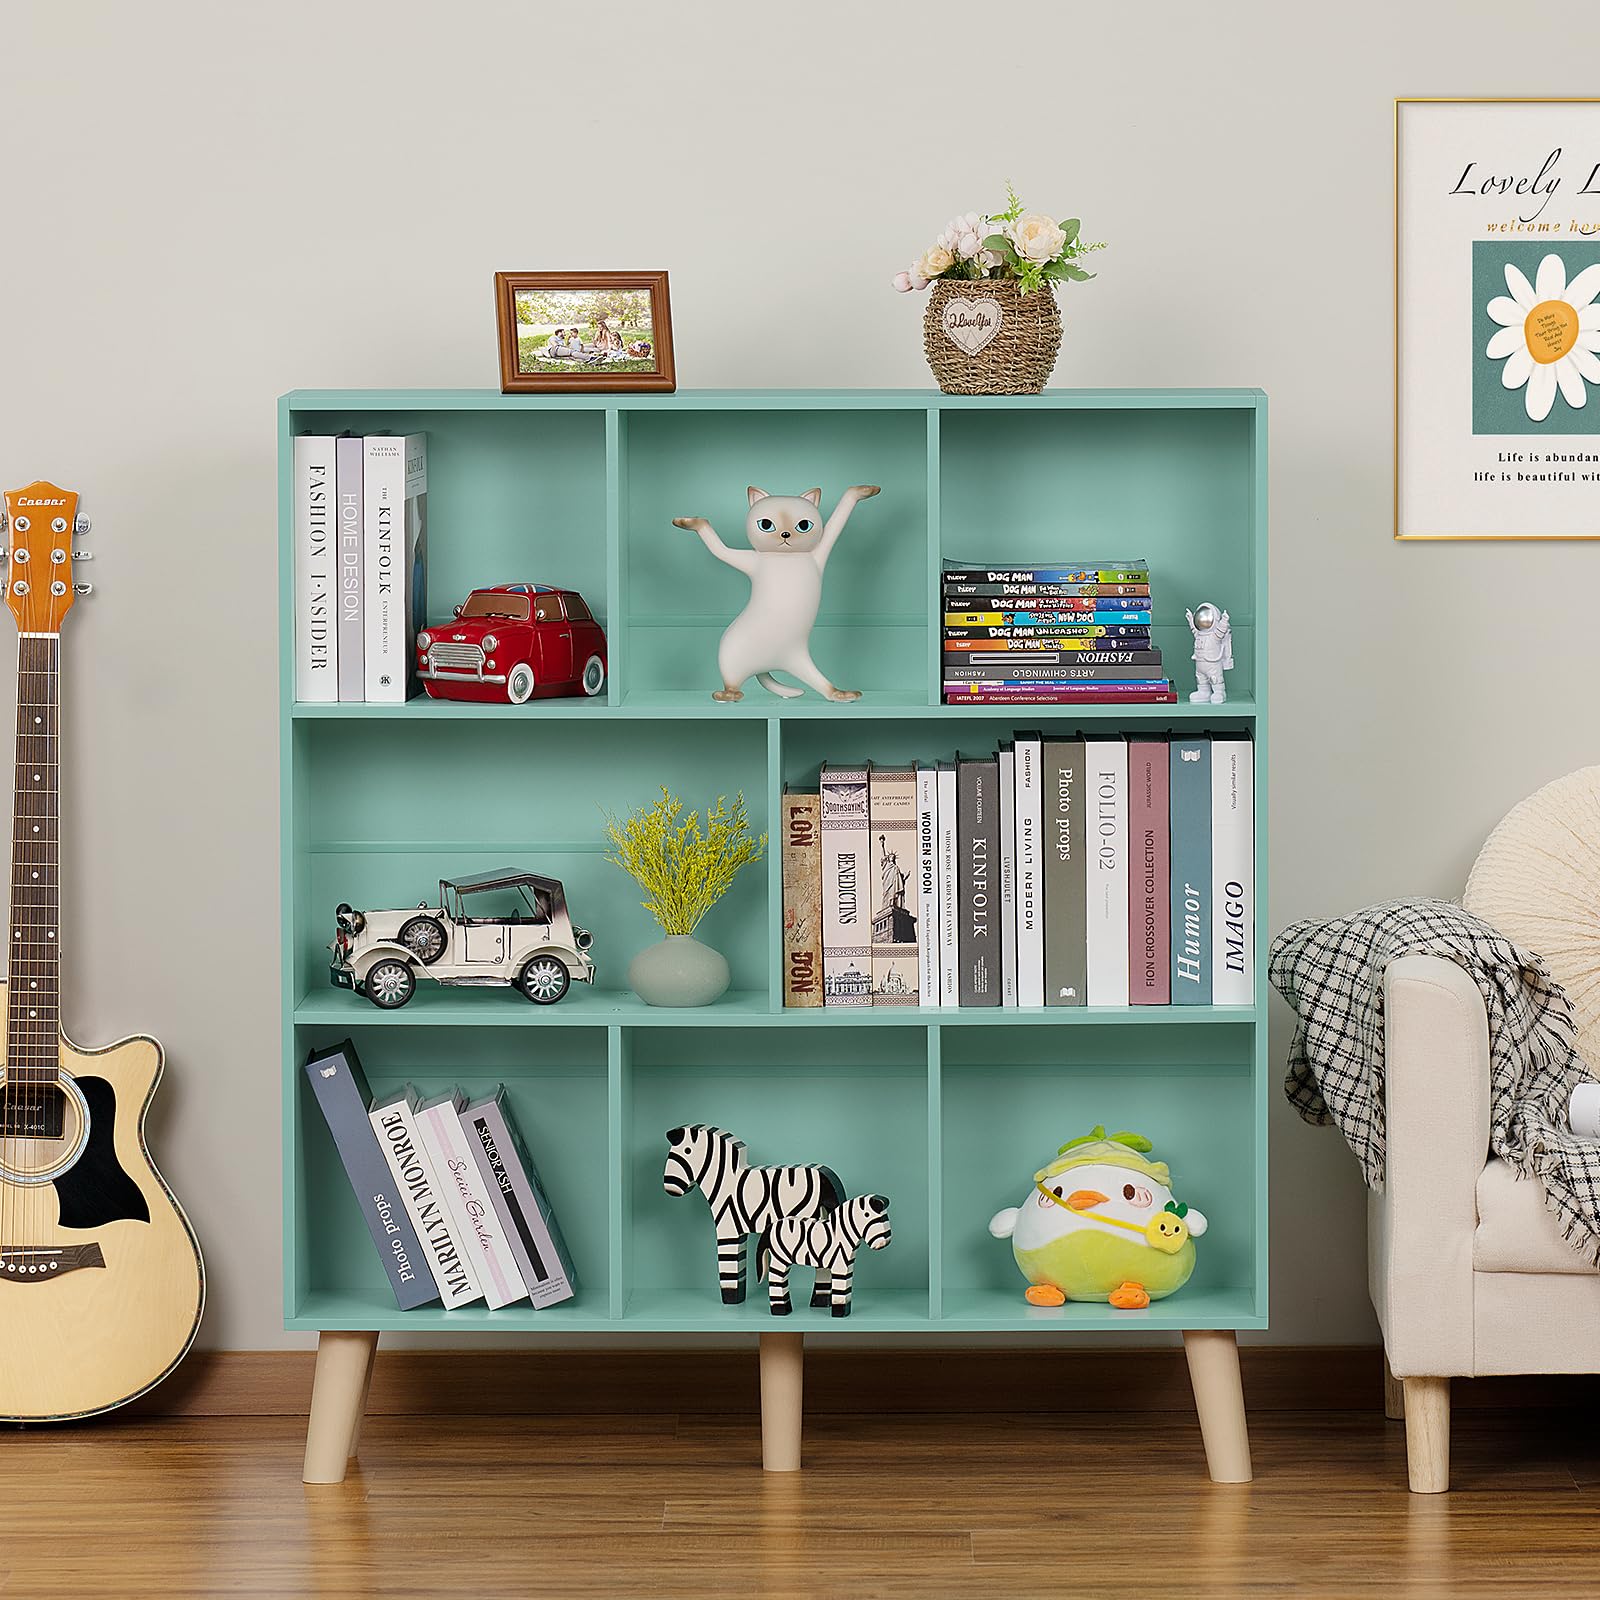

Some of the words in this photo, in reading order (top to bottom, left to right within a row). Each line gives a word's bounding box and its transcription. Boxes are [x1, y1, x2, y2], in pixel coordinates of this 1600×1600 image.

[1448, 147, 1562, 223] Lovely
[1487, 220, 1561, 232] welcome
[1474, 472, 1496, 481] life
[1502, 472, 1511, 481] is
[1517, 472, 1575, 481] beautiful
[1498, 452, 1524, 462] Life
[1530, 452, 1540, 462] is
[17, 497, 66, 506] Caesar
[310, 465, 326, 557] FASHION
[342, 494, 358, 548] HOME
[379, 507, 392, 594] KINFOLK
[987, 572, 1010, 581] DOG
[1012, 572, 1033, 581] MAN
[1003, 584, 1019, 594] DOG
[1020, 585, 1036, 594] MAN
[991, 600, 1013, 608] DOG
[1015, 600, 1036, 608] MAN
[1058, 613, 1075, 622] MAN
[1076, 613, 1094, 622] DOG
[989, 628, 1011, 637] DOG
[1013, 628, 1034, 636] MAN
[1007, 640, 1024, 649] DOG
[1024, 640, 1041, 649] MAN
[1076, 653, 1134, 663] FASHION
[825, 801, 865, 814] SOOTHSAYING
[1059, 768, 1073, 812] Photo
[790, 807, 813, 846] LON
[922, 812, 931, 855] WOODEN
[1056, 818, 1070, 860] props
[1098, 772, 1116, 869] FOLIO-02
[922, 860, 932, 894] SPOON
[1145, 830, 1154, 893] COLLECTION
[838, 853, 857, 924] BENEDICTINS
[972, 838, 987, 937] KINFOLK
[1146, 896, 1154, 958] CROSSOVER
[1178, 883, 1200, 983] Humor
[1225, 882, 1244, 974] IMAGO
[791, 952, 813, 992] DON
[1146, 962, 1154, 986] FION
[381, 1112, 434, 1202] MONROE
[478, 1126, 501, 1168] SENIOR
[495, 1169, 512, 1193] ASH
[374, 1194, 400, 1235] props
[466, 1200, 493, 1252] Garden
[391, 1240, 416, 1283] Photo
[417, 1201, 472, 1297] MARILYN
